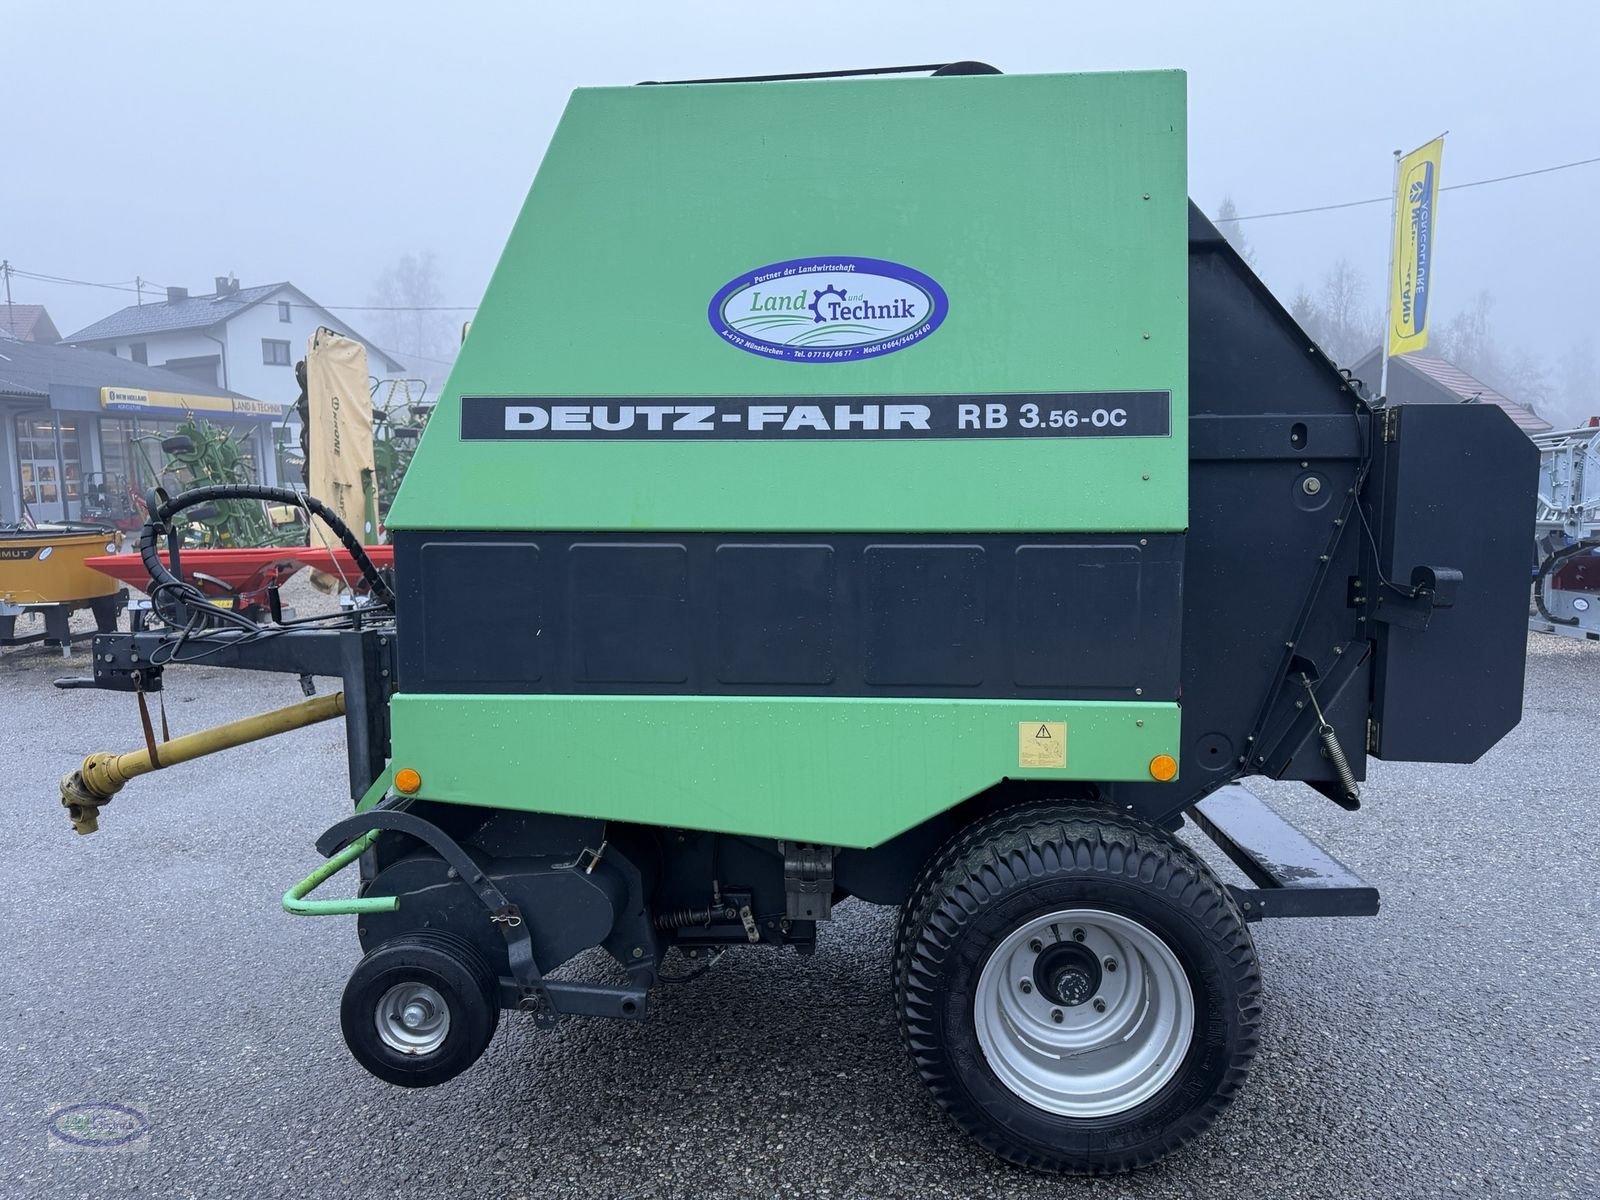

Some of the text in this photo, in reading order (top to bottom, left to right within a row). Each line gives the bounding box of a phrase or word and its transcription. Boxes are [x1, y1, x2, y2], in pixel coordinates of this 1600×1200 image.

[754, 263, 856, 284] Partner der Landwirtschaft
[750, 289, 916, 321] Land und Technik
[744, 341, 784, 355] Münzkirchen
[794, 350, 806, 358] Tel.
[863, 345, 881, 354] Mobil
[234, 400, 251, 412] LAND
[256, 402, 282, 414] TECHNIK
[504, 402, 1128, 431] DEUTZ-FAHR RB 3.56-OC
[0, 549, 29, 559] MUT
